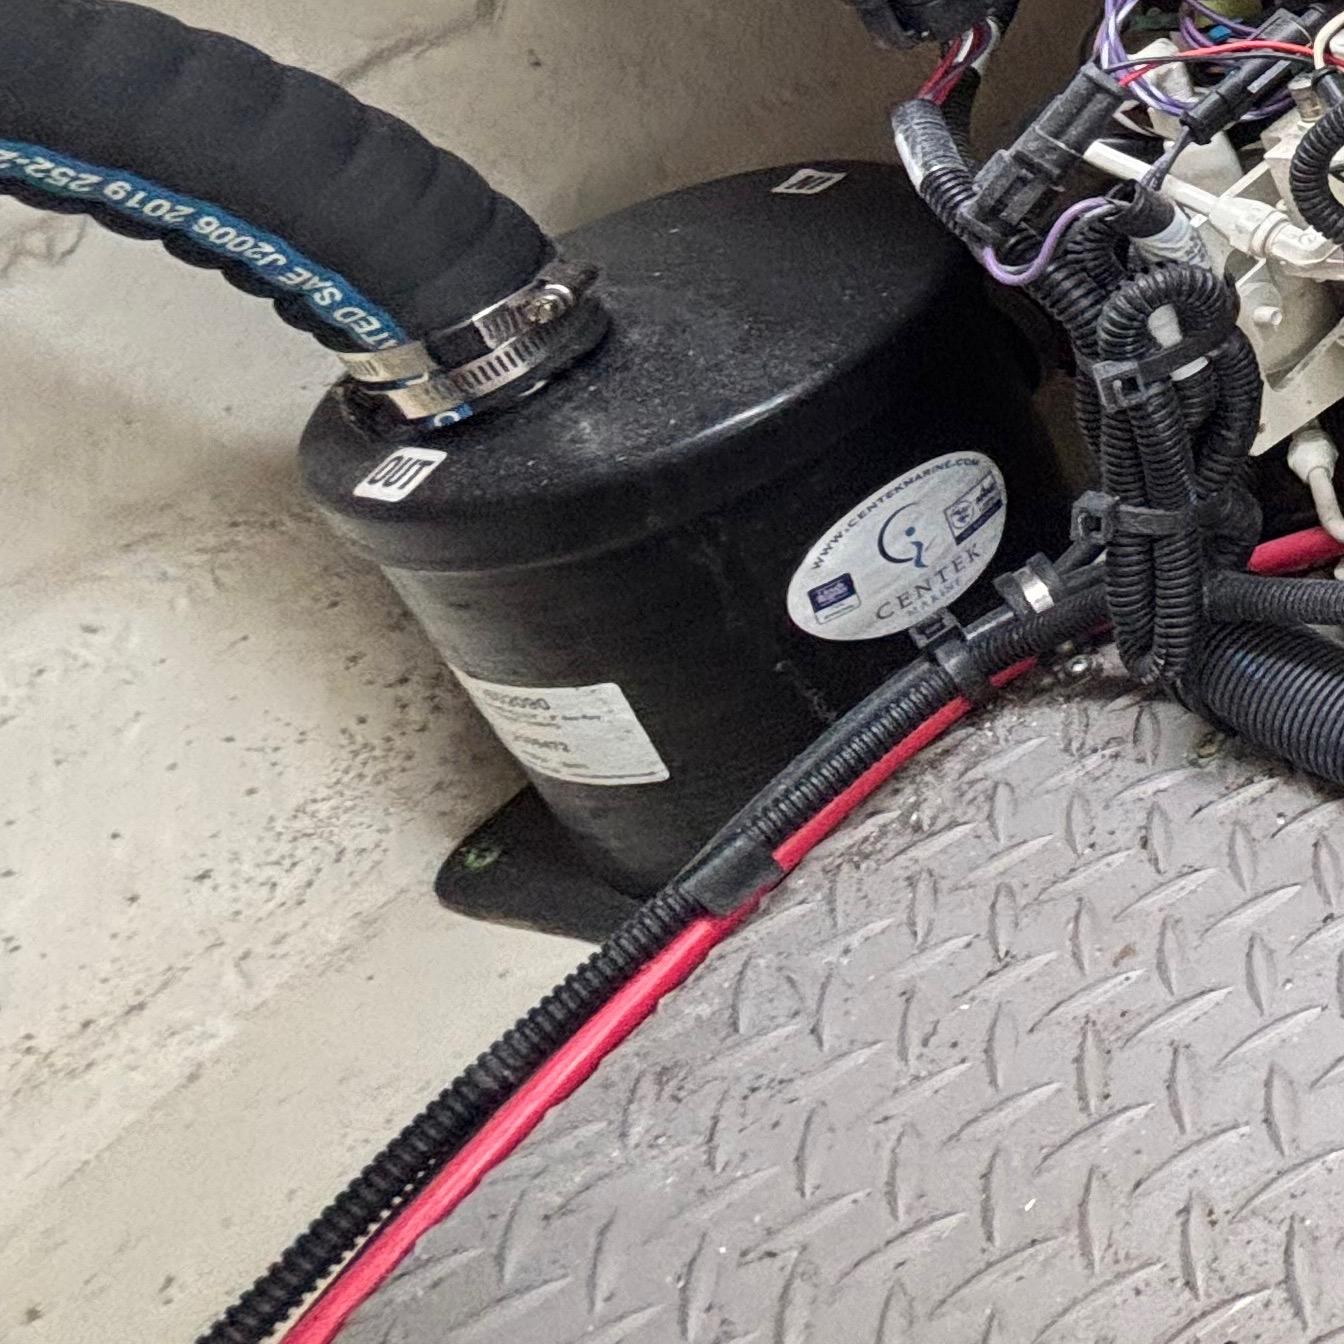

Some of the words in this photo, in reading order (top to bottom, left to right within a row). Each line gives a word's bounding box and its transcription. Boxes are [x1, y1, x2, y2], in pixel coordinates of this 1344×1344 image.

[103, 179, 199, 224] 2019
[192, 215, 288, 267] J2006
[278, 266, 344, 308] SAE
[366, 455, 434, 490] OUT
[874, 542, 982, 621] CENTEK
